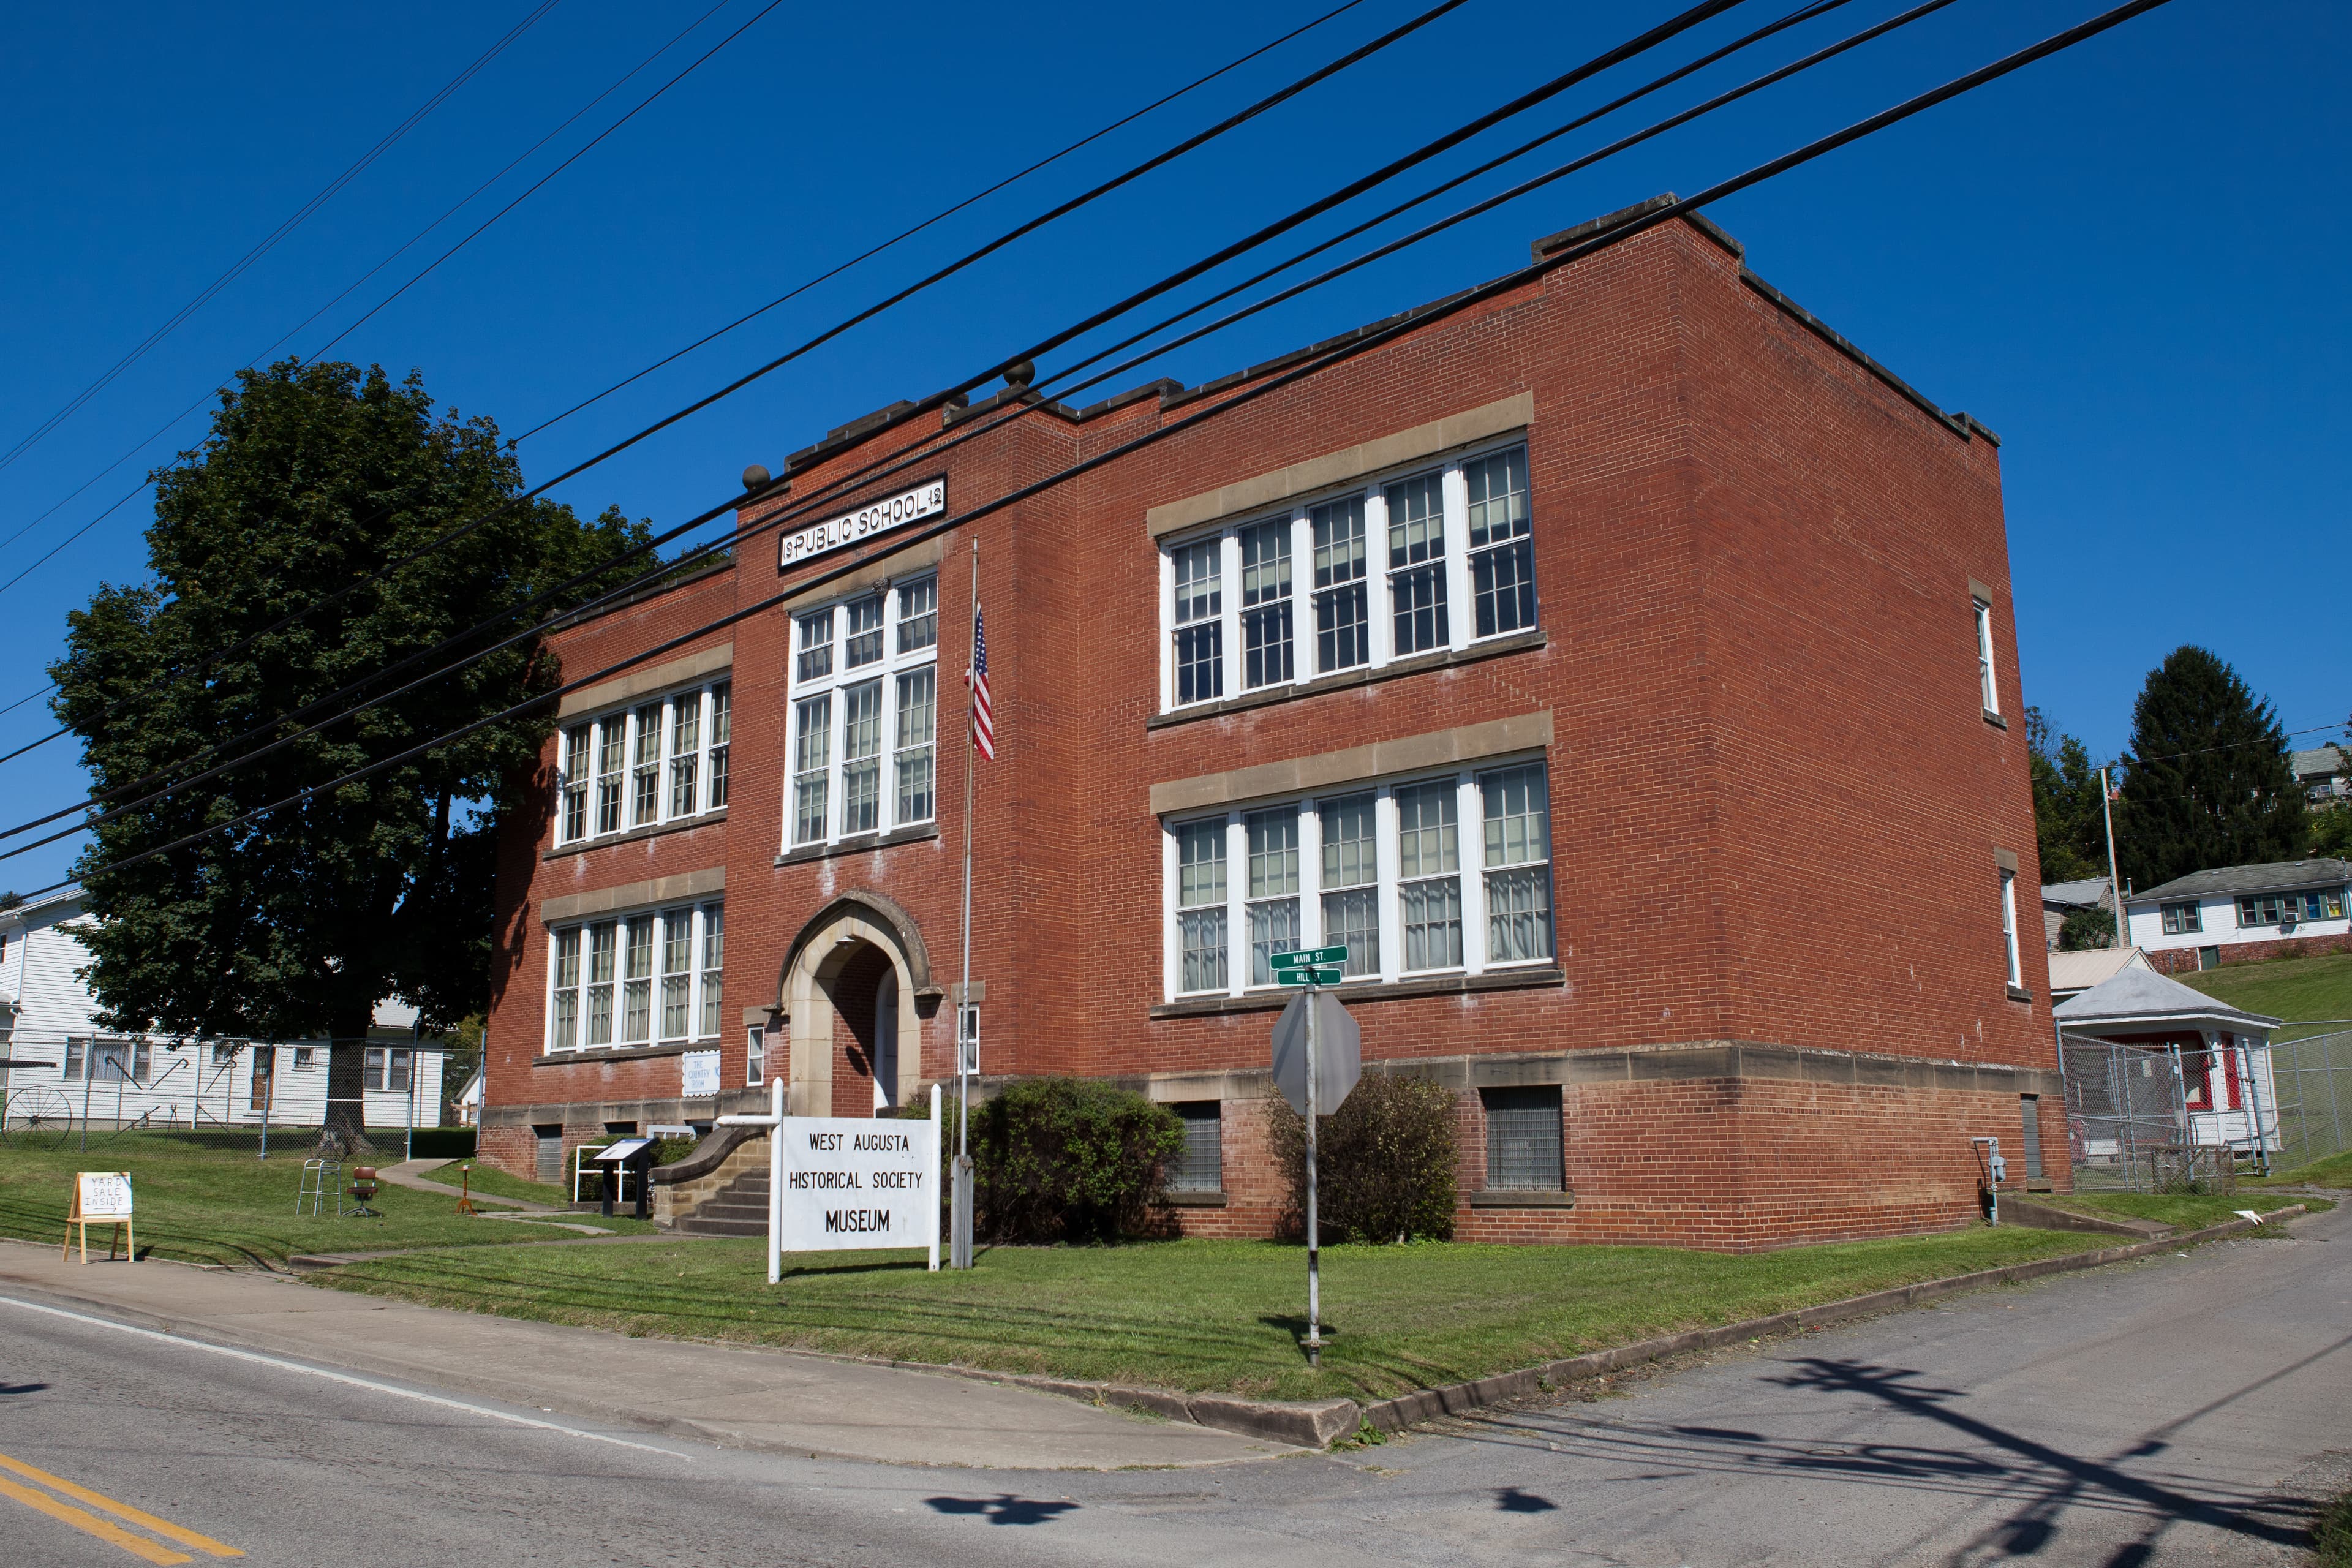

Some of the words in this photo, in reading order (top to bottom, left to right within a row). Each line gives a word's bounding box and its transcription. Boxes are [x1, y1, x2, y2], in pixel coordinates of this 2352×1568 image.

[795, 518, 852, 558] PUBLIC
[858, 492, 927, 535] SCHOOL
[1293, 954, 1310, 964] MAIN
[1315, 951, 1326, 962] ST.
[1296, 973, 1310, 982] HILL
[1314, 972, 1322, 981] ST.
[688, 1069, 710, 1079] COUNTRY
[810, 1133, 843, 1151] WEST
[853, 1134, 909, 1152] AUGUSTA
[790, 1172, 862, 1189] HISTORICAL
[873, 1172, 922, 1188] SOCIETY
[93, 1188, 121, 1196] SALE
[826, 1210, 889, 1232] MUSEUM
